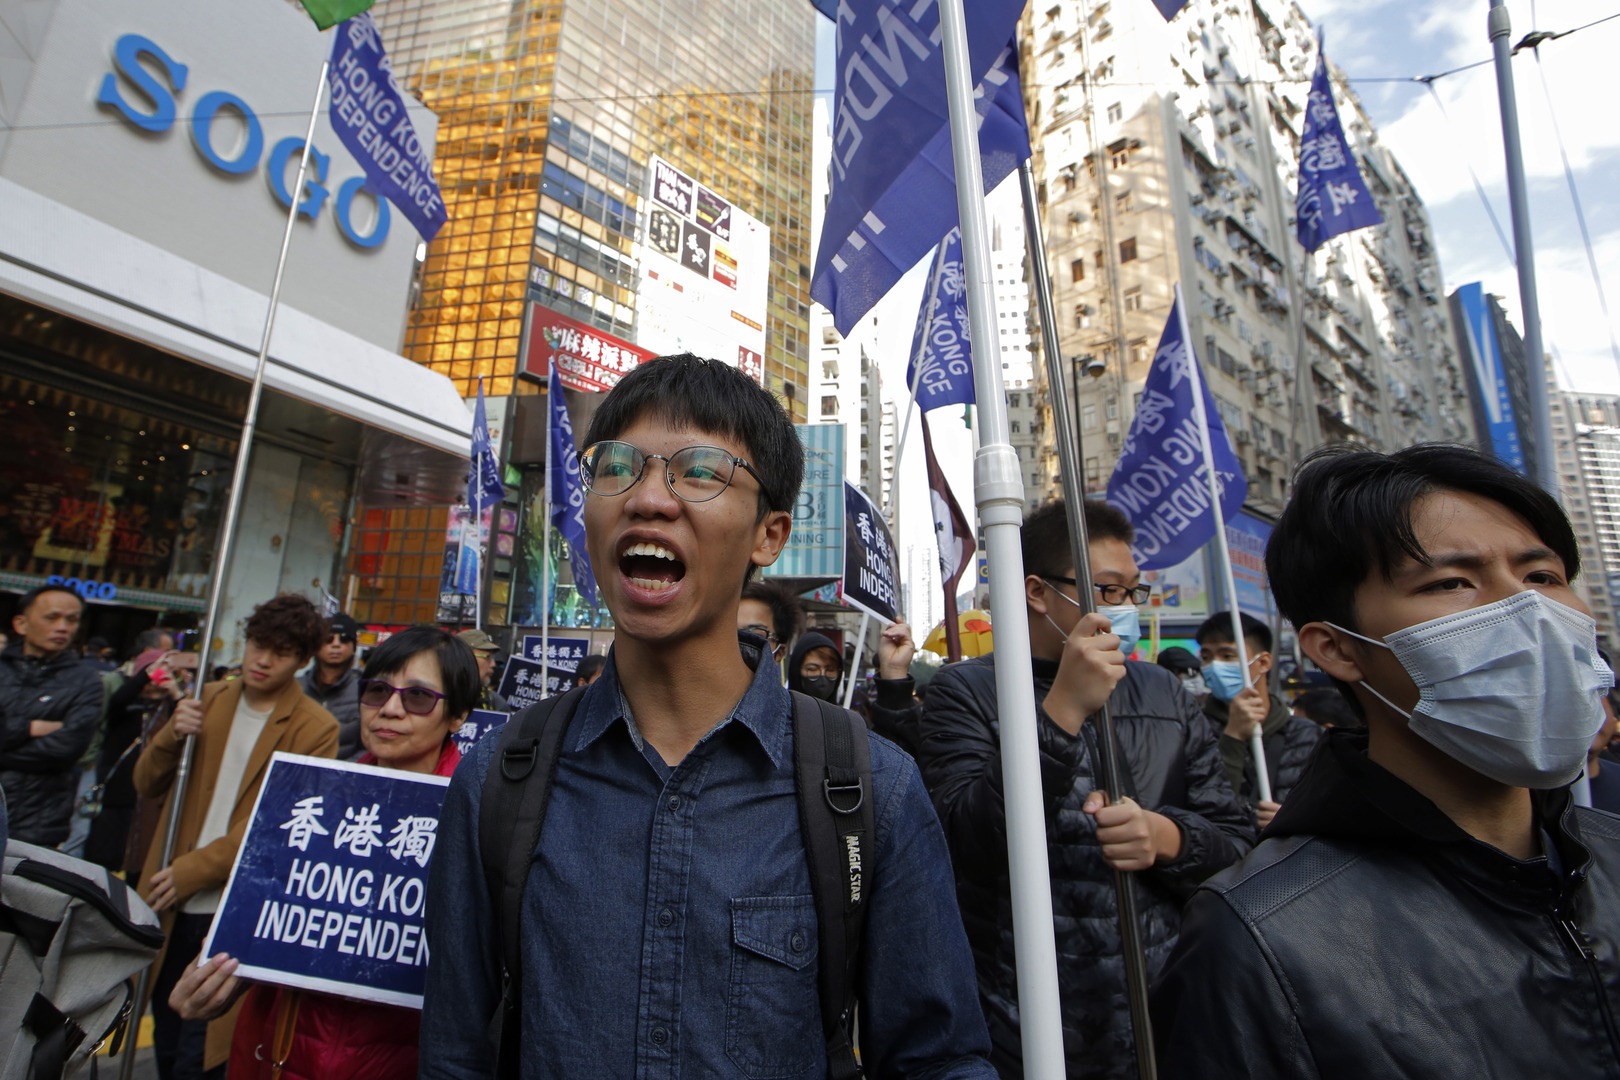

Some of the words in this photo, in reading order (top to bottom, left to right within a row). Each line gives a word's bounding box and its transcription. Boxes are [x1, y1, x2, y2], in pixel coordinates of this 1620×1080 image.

[339, 48, 397, 126] HONG
[97, 33, 391, 248] SOGO
[930, 311, 969, 376] KONG
[866, 547, 892, 586] HONG
[515, 685, 541, 700] HONG
[279, 795, 439, 868] 香港獨
[846, 835, 862, 873] MAGIC
[284, 858, 374, 907] HONG
[377, 873, 425, 919] KO
[850, 874, 862, 904] STAR
